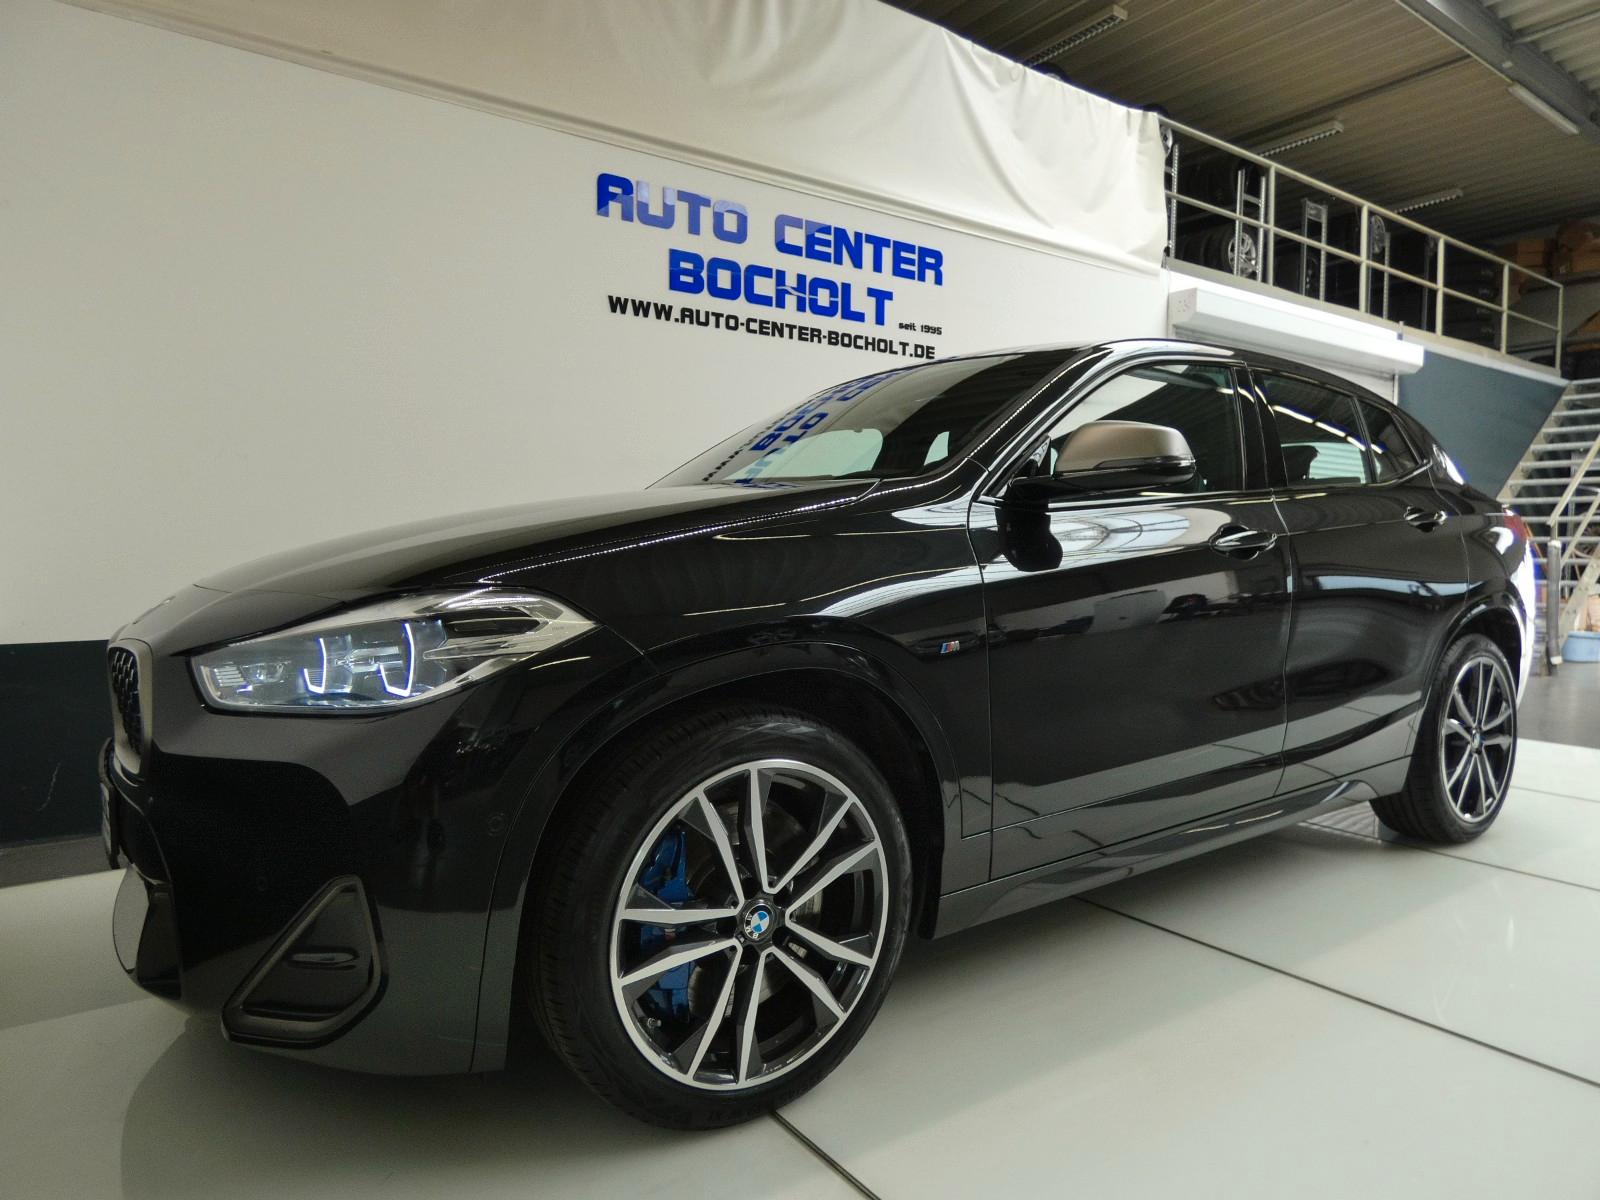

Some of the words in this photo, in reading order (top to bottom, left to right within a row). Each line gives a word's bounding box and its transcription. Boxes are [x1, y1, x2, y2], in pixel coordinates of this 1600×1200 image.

[597, 173, 748, 244] AUTO
[775, 214, 943, 285] CENTER
[669, 248, 893, 326] BOCHOLT
[608, 295, 935, 359] WWW.AUTO-CENTER-BOCHOLT.DE
[899, 322, 917, 331] seit
[920, 324, 942, 335] 1995
